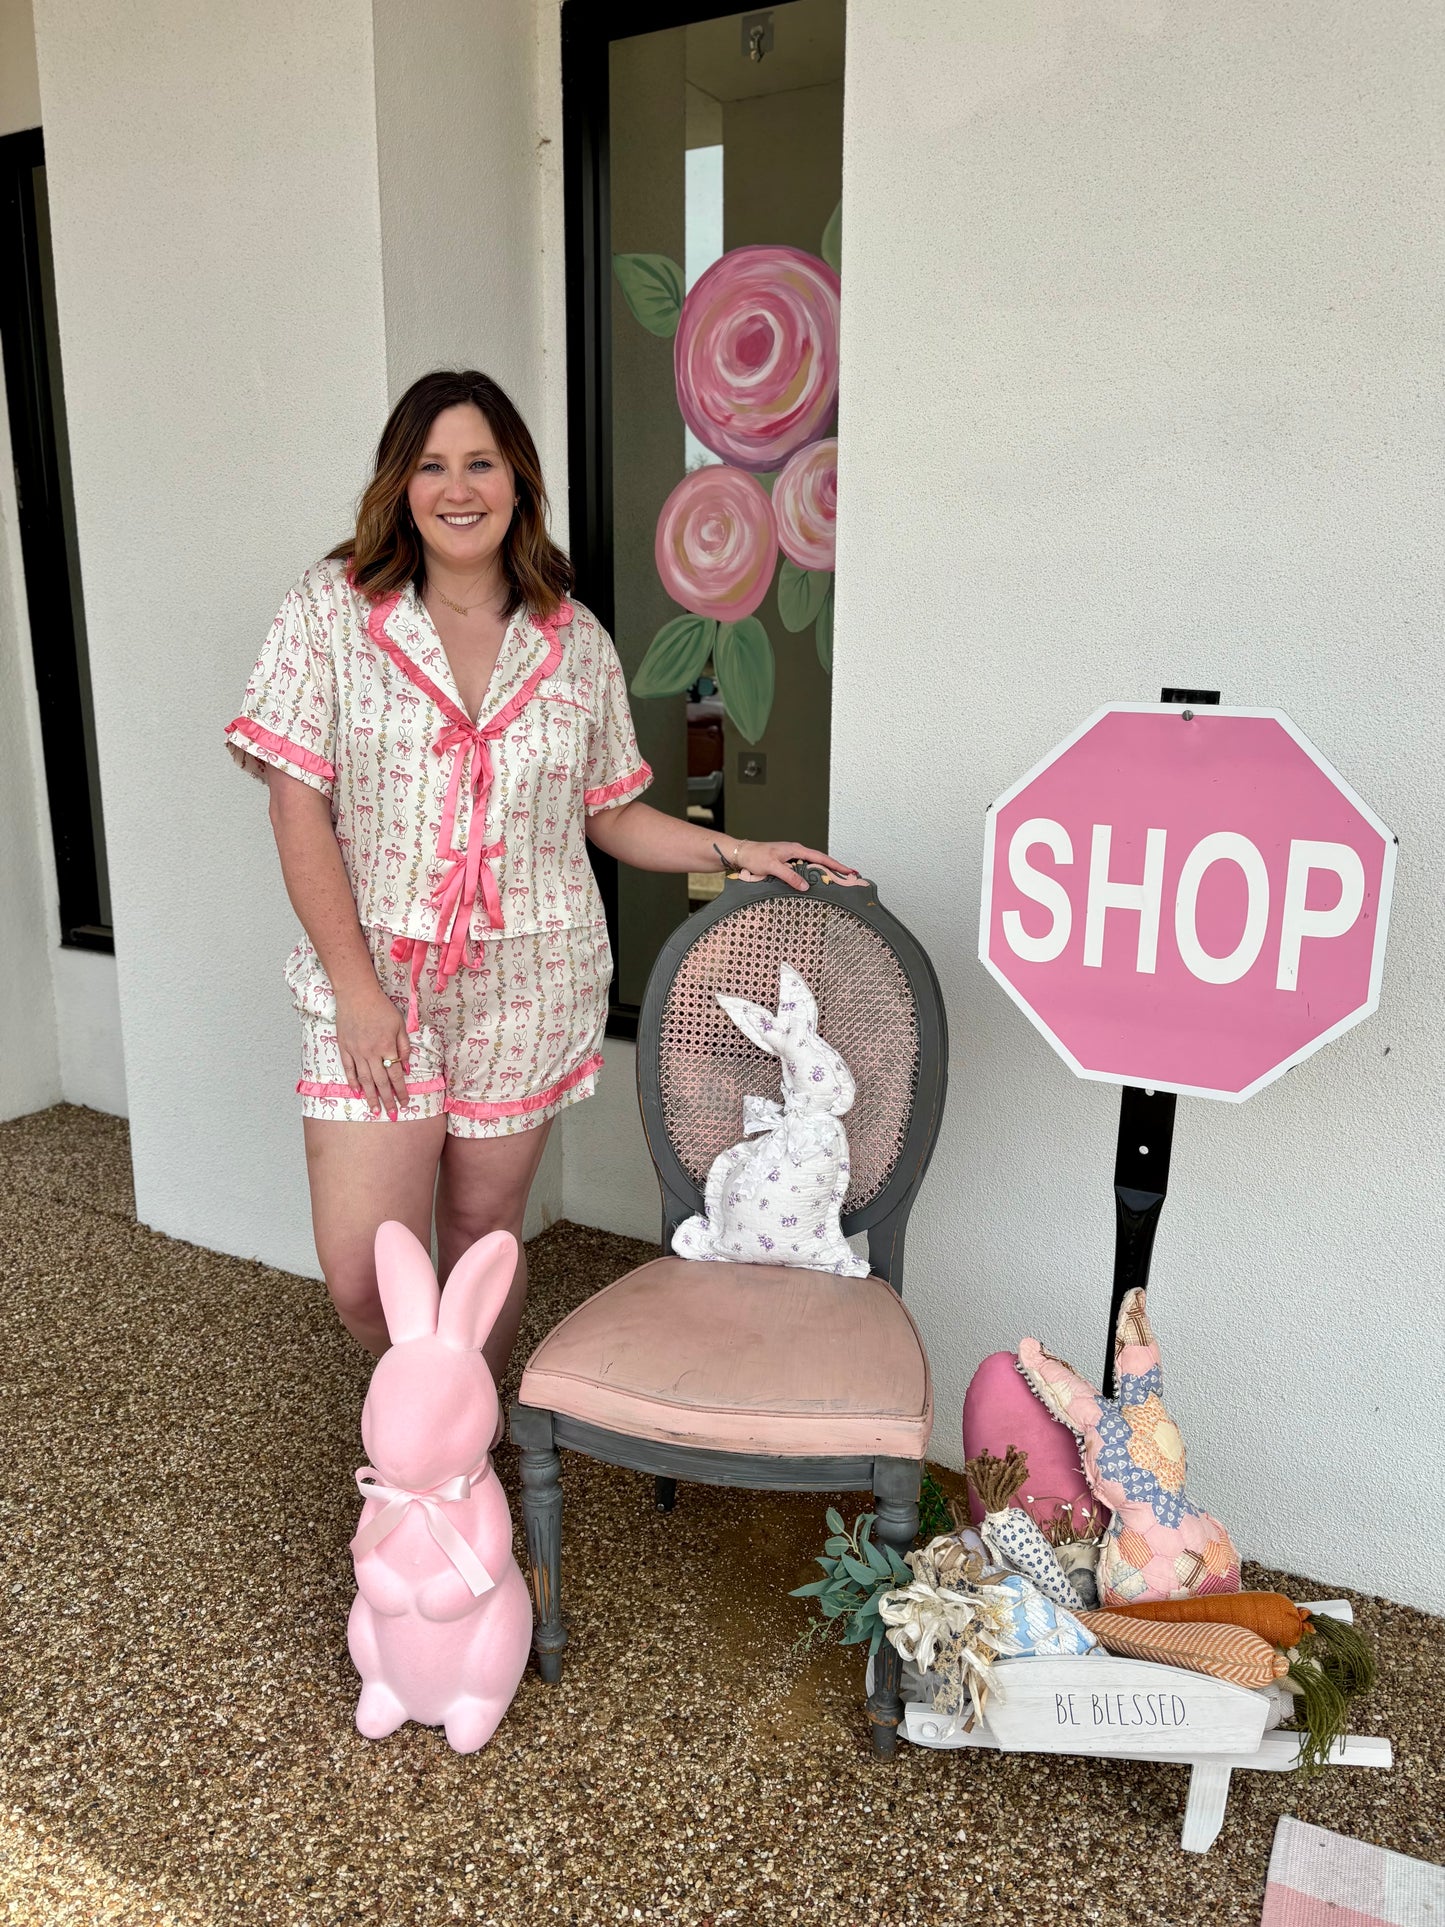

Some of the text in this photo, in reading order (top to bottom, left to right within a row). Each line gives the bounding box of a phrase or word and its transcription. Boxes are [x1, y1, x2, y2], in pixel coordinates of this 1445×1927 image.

[1002, 818, 1366, 991] SHOP
[1055, 1693, 1190, 1726] BE BLESSED.
